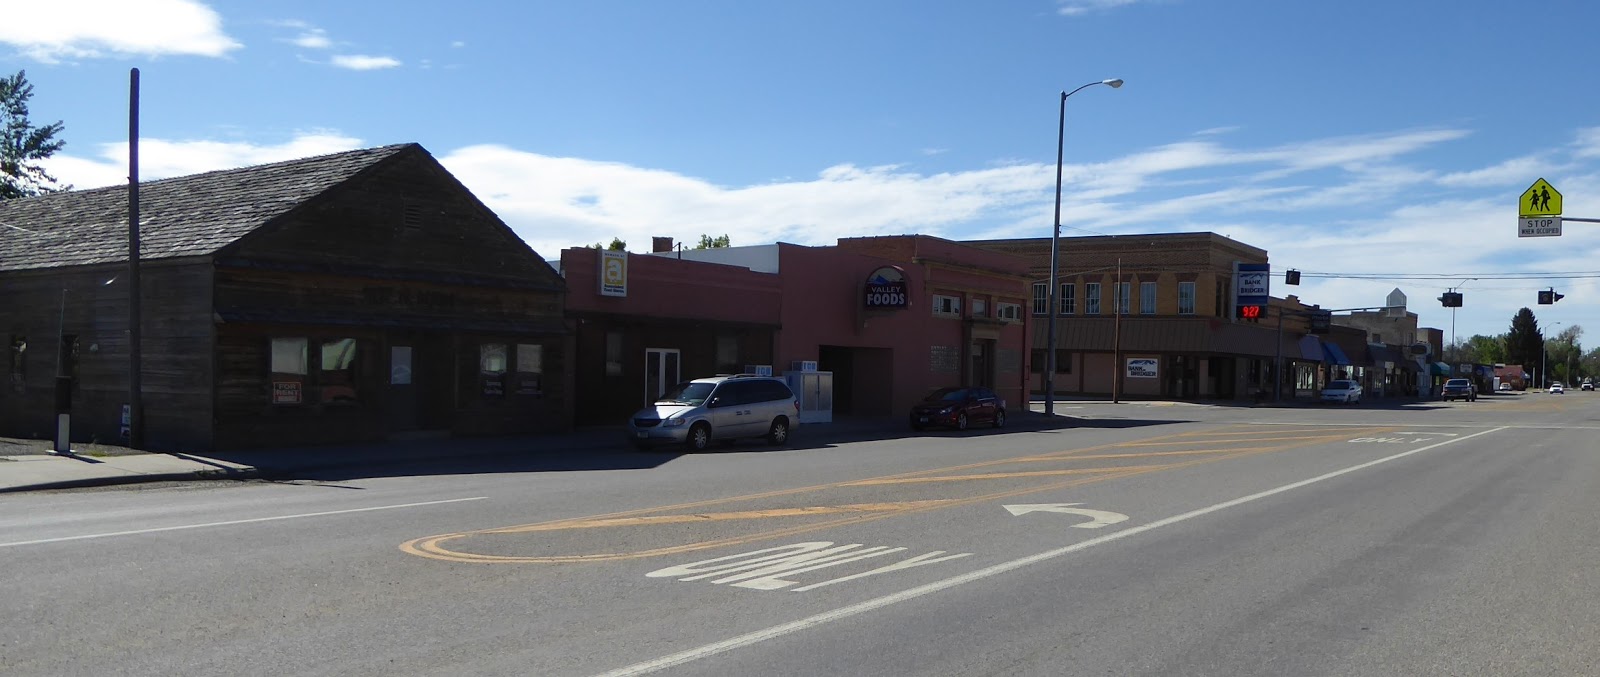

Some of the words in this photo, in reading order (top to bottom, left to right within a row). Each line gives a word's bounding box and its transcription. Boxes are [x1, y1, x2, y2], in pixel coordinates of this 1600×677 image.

[1527, 219, 1553, 228] STOP
[867, 293, 905, 305] FOODS
[645, 541, 975, 592] ONLY
